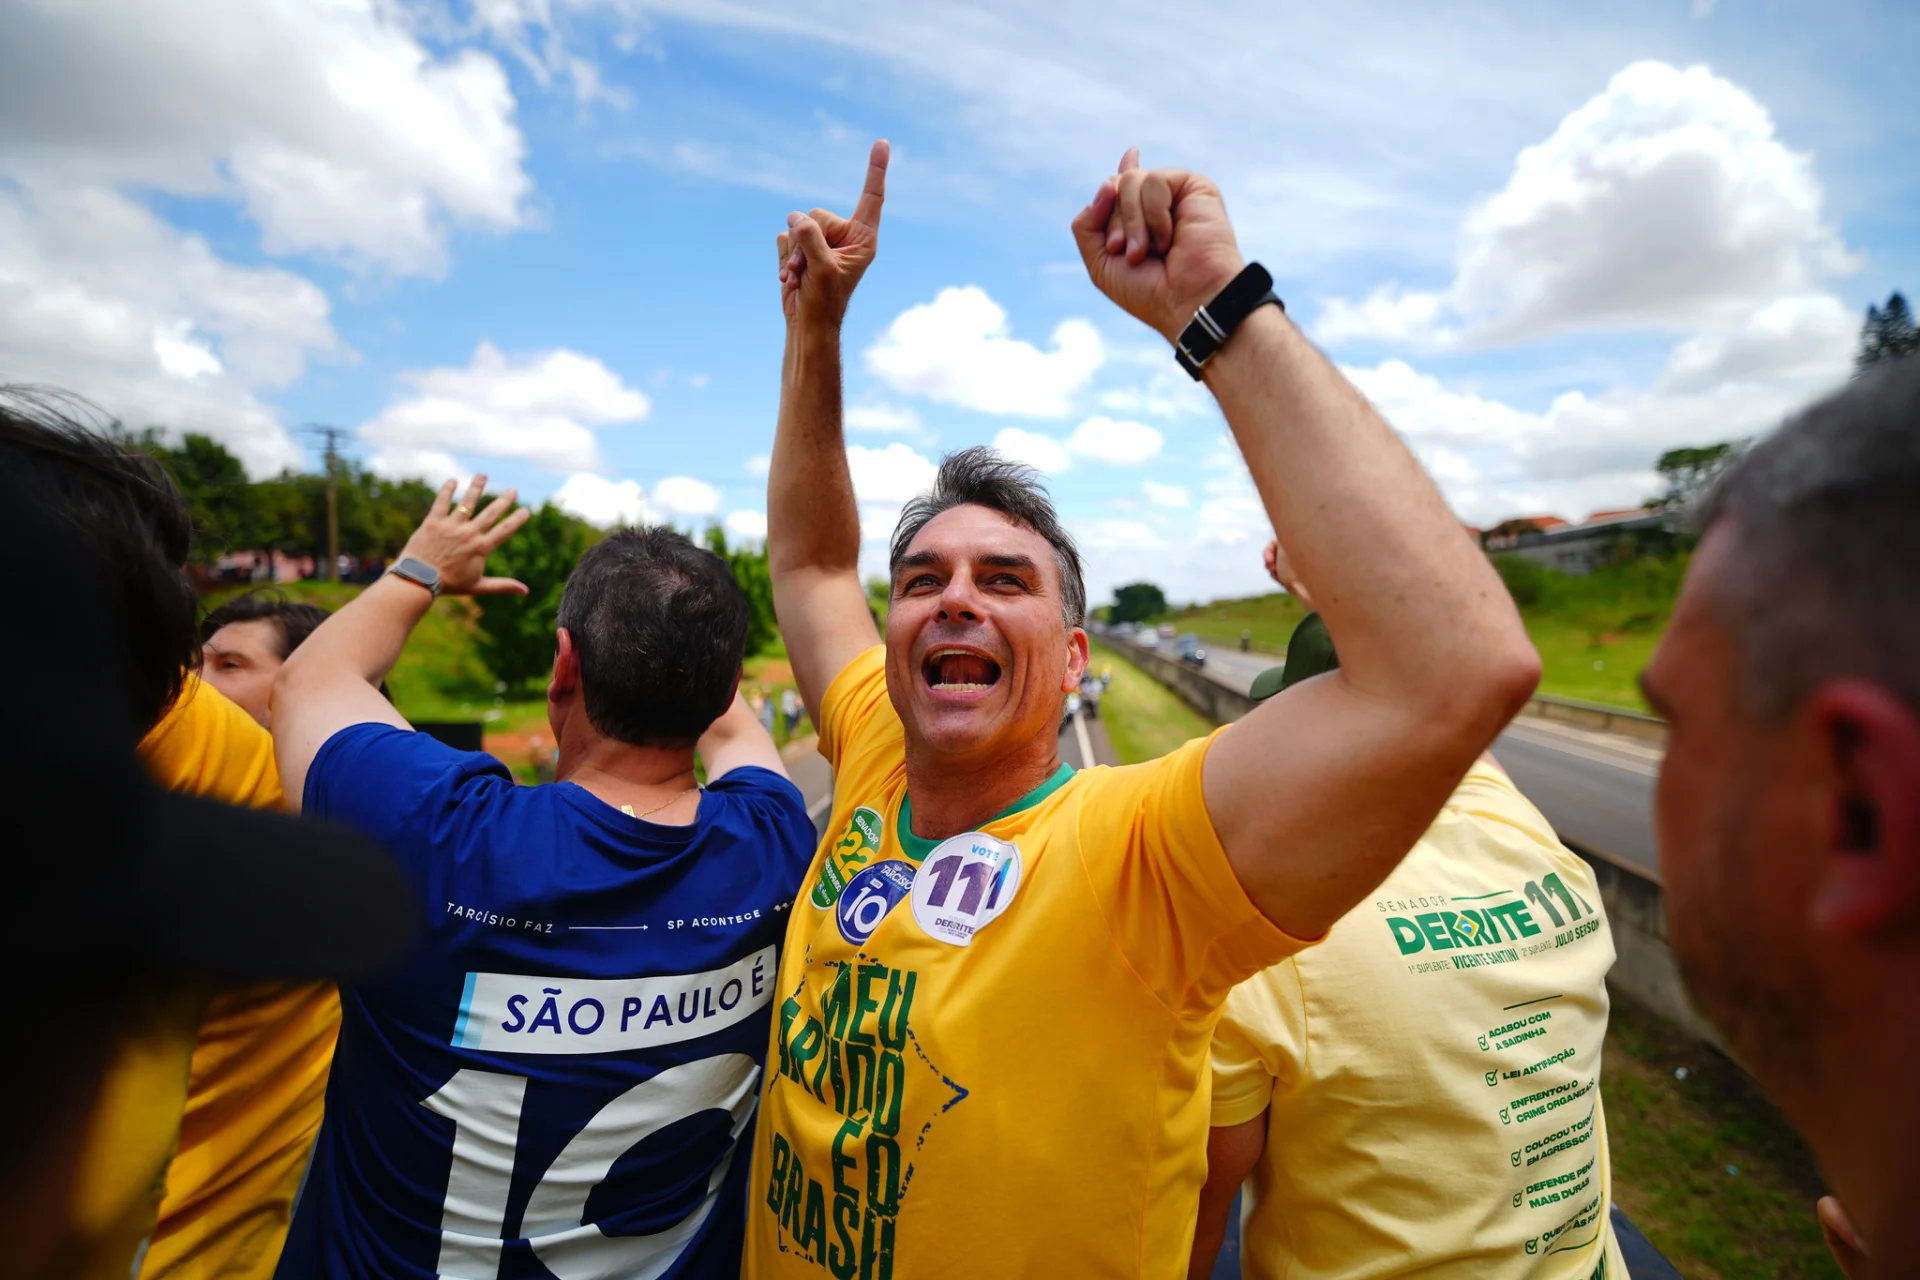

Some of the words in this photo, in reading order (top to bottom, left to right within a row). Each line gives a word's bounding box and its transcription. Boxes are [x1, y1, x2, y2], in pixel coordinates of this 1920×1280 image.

[855, 816, 879, 845] SENADOR
[971, 844, 1000, 861] VOTE
[843, 886, 888, 934] 10
[1376, 896, 1448, 912] SENADOR
[447, 902, 517, 928] TARCÍSIO
[524, 920, 554, 934] FAZ
[667, 919, 685, 930] SP
[692, 909, 761, 928] ACONTECE
[1386, 899, 1542, 955] DERRITE
[1555, 930, 1574, 949] JULIO
[1451, 953, 1487, 970] VICENTE
[1487, 948, 1520, 965] SANTINI
[501, 987, 605, 1035] SÃO
[620, 978, 742, 1033] PAULO
[751, 956, 765, 998] É
[1488, 1019, 1527, 1038] ACABOU
[1528, 1011, 1552, 1025] COM
[1495, 1042, 1503, 1051] A
[1502, 1027, 1547, 1048] SAIDINHA
[1502, 1069, 1521, 1080] LEI
[1522, 1047, 1576, 1077] ANTIFACÇÃO
[1510, 1082, 1570, 1110] ENFRENTOU
[1571, 1080, 1579, 1088] O
[1516, 1105, 1547, 1123] CRIME
[1524, 1128, 1570, 1154] COLOCOU
[419, 1053, 762, 1280] 10
[1527, 1153, 1540, 1167] EM
[1526, 1171, 1576, 1194] DEFENDE
[1529, 1193, 1560, 1209] MAIS
[1560, 1177, 1590, 1199] DURAS
